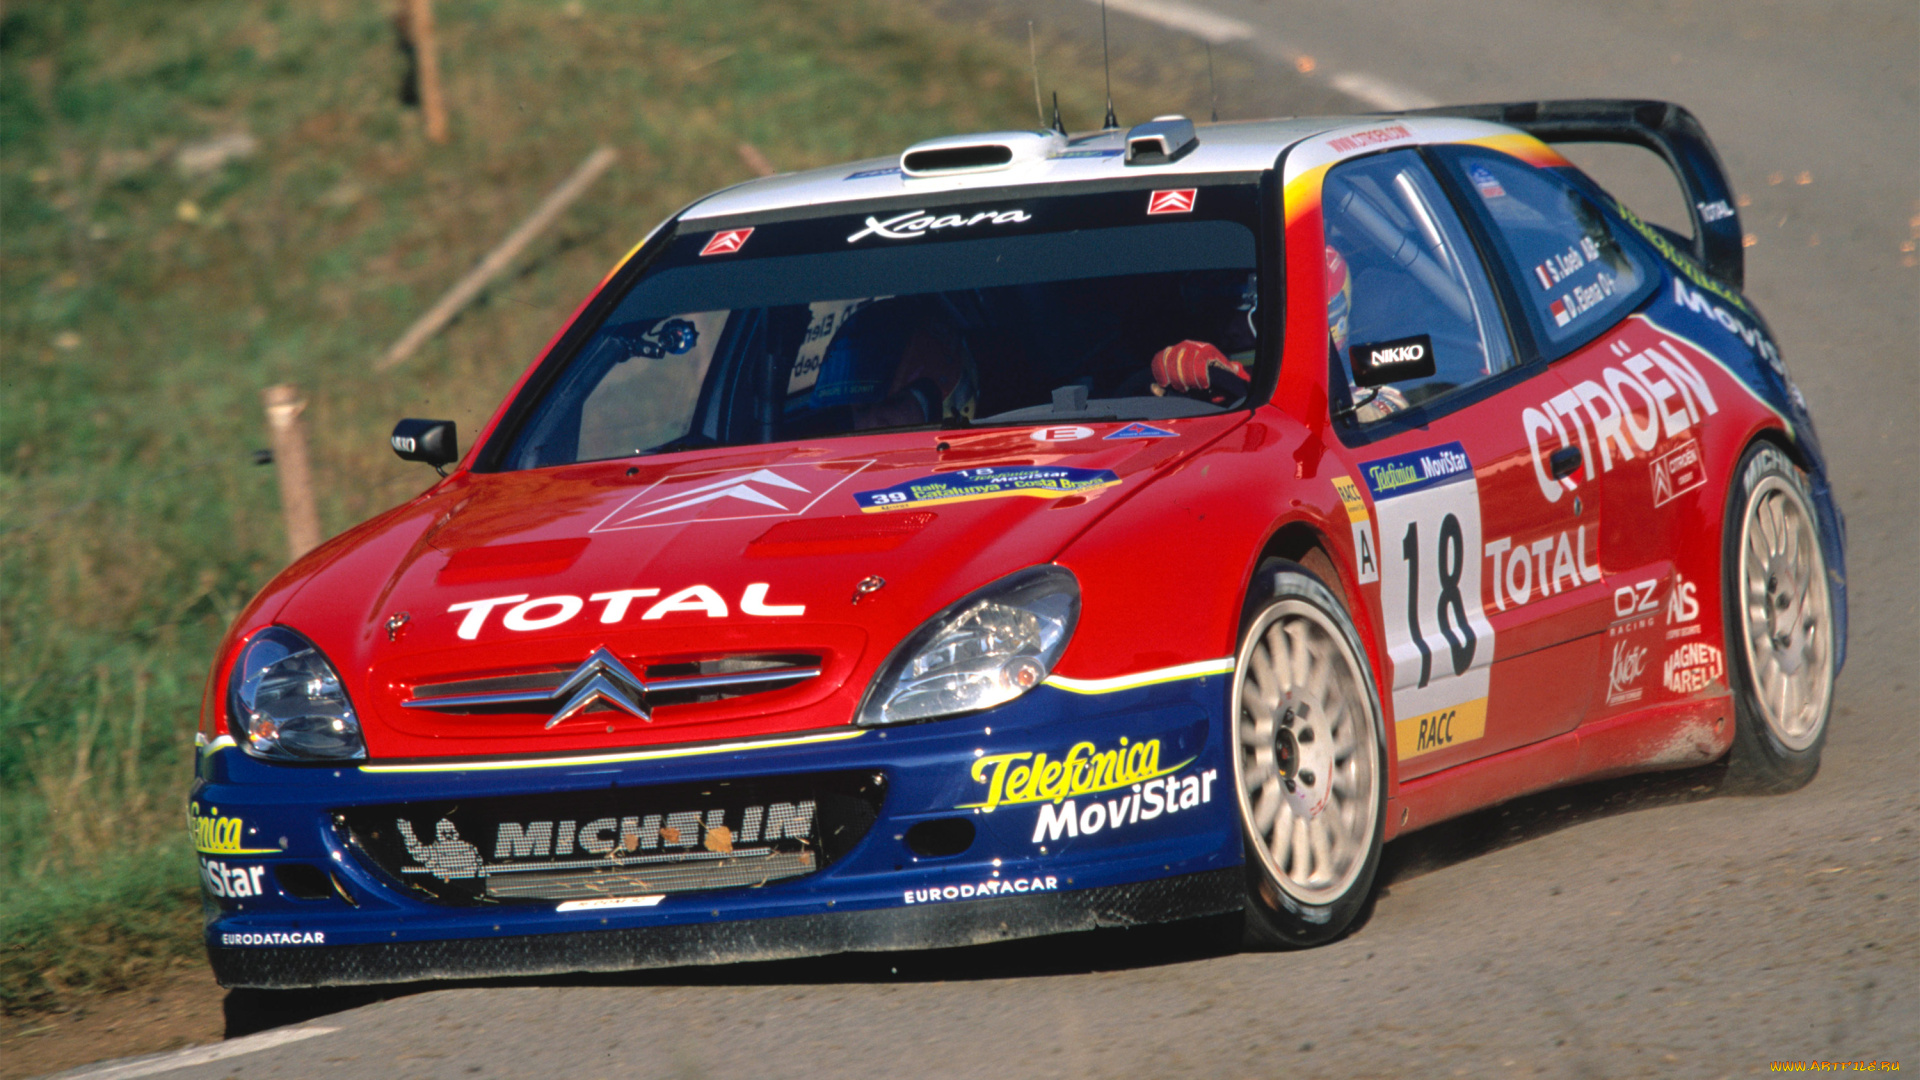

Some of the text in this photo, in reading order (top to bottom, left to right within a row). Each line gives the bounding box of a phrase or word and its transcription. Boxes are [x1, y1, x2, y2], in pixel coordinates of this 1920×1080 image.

[847, 209, 1032, 243] Xsara
[1371, 344, 1424, 367] NIKKO
[1045, 427, 1078, 440] E
[1420, 451, 1468, 479] MoviStar
[872, 491, 907, 504] 39
[910, 483, 947, 494] Rally
[914, 482, 1000, 499] Catalunya
[1014, 478, 1057, 488] Costa
[1059, 478, 1103, 489] Brava
[1337, 484, 1362, 503] RACC
[1360, 529, 1375, 575] A
[1485, 525, 1600, 611] TOTAL
[447, 583, 806, 640] TOTAL
[1402, 512, 1477, 690] 18
[1609, 617, 1655, 637] RACING
[1417, 710, 1456, 752] RACC
[1032, 769, 1217, 843] MoviStar
[494, 801, 816, 858] MICHELIN
[903, 876, 1058, 904] EURODATACAR
[221, 932, 325, 945] EURODATACAR
